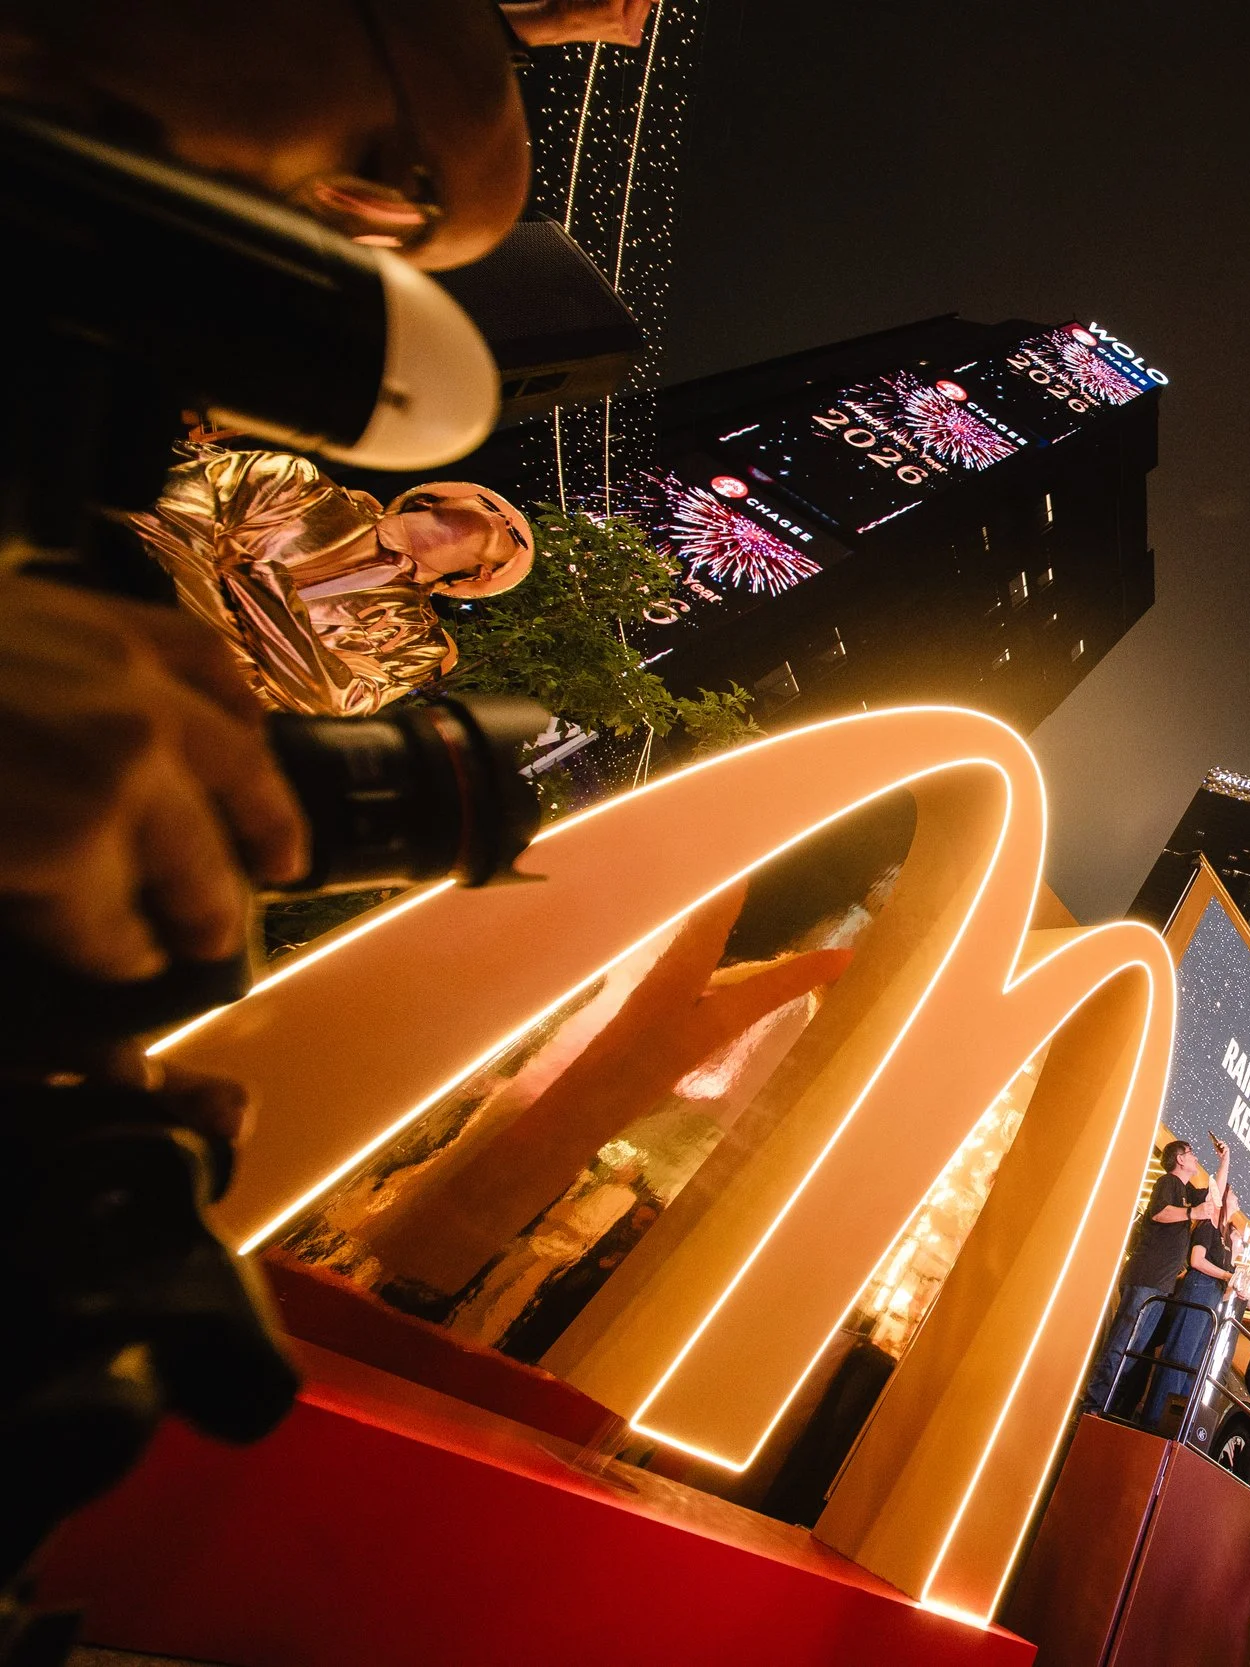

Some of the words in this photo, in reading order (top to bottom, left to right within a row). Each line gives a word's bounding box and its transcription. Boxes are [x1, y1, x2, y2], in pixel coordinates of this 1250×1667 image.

[1088, 321, 1169, 385] WOLO
[1096, 347, 1148, 386] CHAGEE
[1005, 353, 1089, 413] 2026
[811, 408, 929, 485] 2026
[844, 401, 889, 431] Happy
[919, 443, 948, 473] Year
[966, 401, 1029, 446] CHAGEE
[745, 497, 814, 543] CHAGEE
[681, 575, 724, 604] Year
